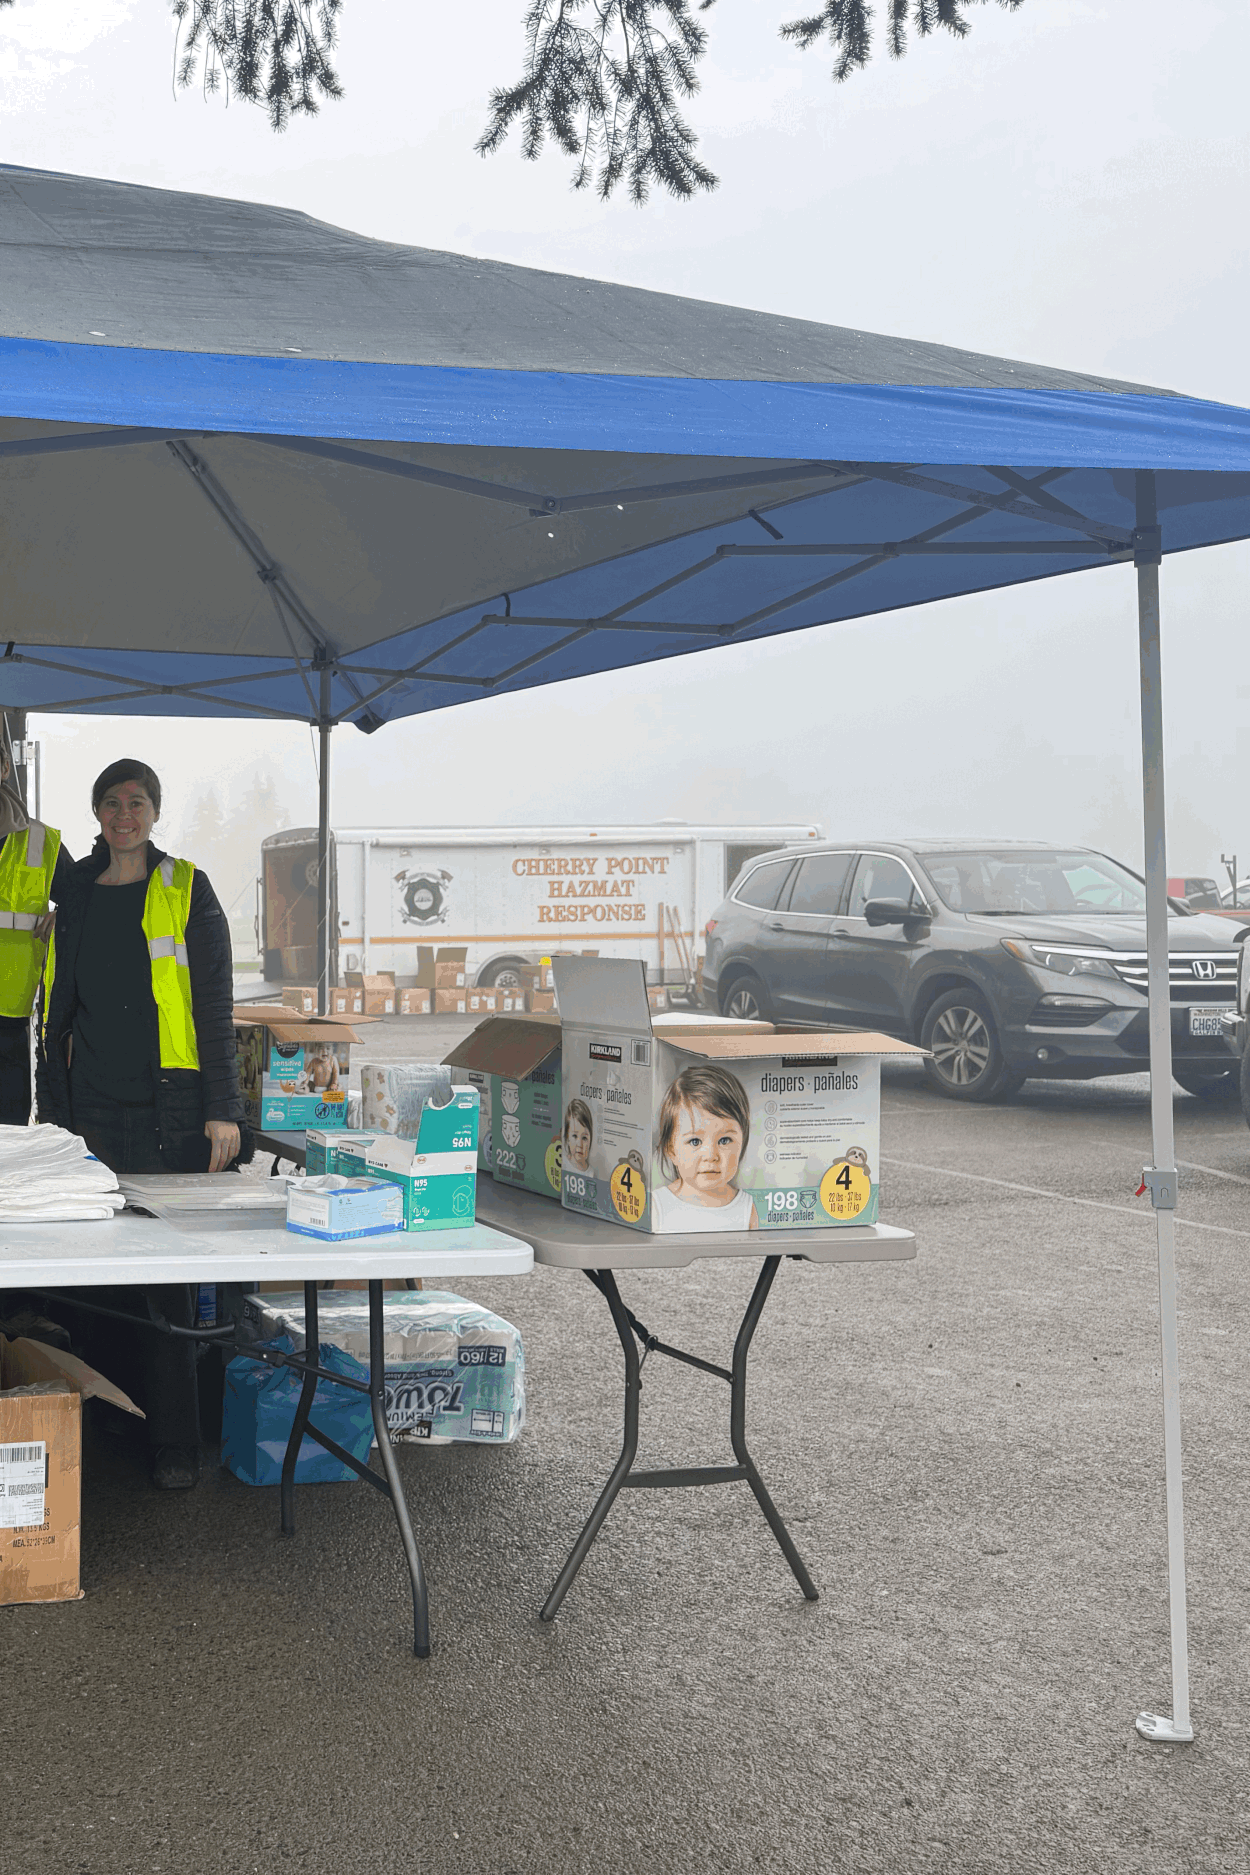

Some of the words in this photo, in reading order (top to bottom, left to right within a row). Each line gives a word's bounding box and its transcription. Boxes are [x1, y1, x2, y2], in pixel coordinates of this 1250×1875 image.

[511, 857, 598, 876] CHERRY
[605, 857, 669, 875] POINT
[548, 880, 635, 898] HAZMAT
[537, 904, 646, 923] RESPONSE
[590, 1044, 621, 1057] KIRKLAND
[580, 1081, 603, 1100] diapers
[606, 1087, 632, 1105] pañales
[761, 1072, 805, 1095] diapers
[813, 1071, 858, 1094] pañales
[452, 1137, 472, 1148] N95
[496, 1148, 517, 1169] 222
[414, 1178, 428, 1188] N95
[564, 1174, 586, 1196] 198
[620, 1167, 633, 1193] 4
[835, 1165, 853, 1191] 4
[764, 1190, 798, 1211] 198
[767, 1210, 789, 1223] diapers
[384, 1382, 464, 1416] Tow
